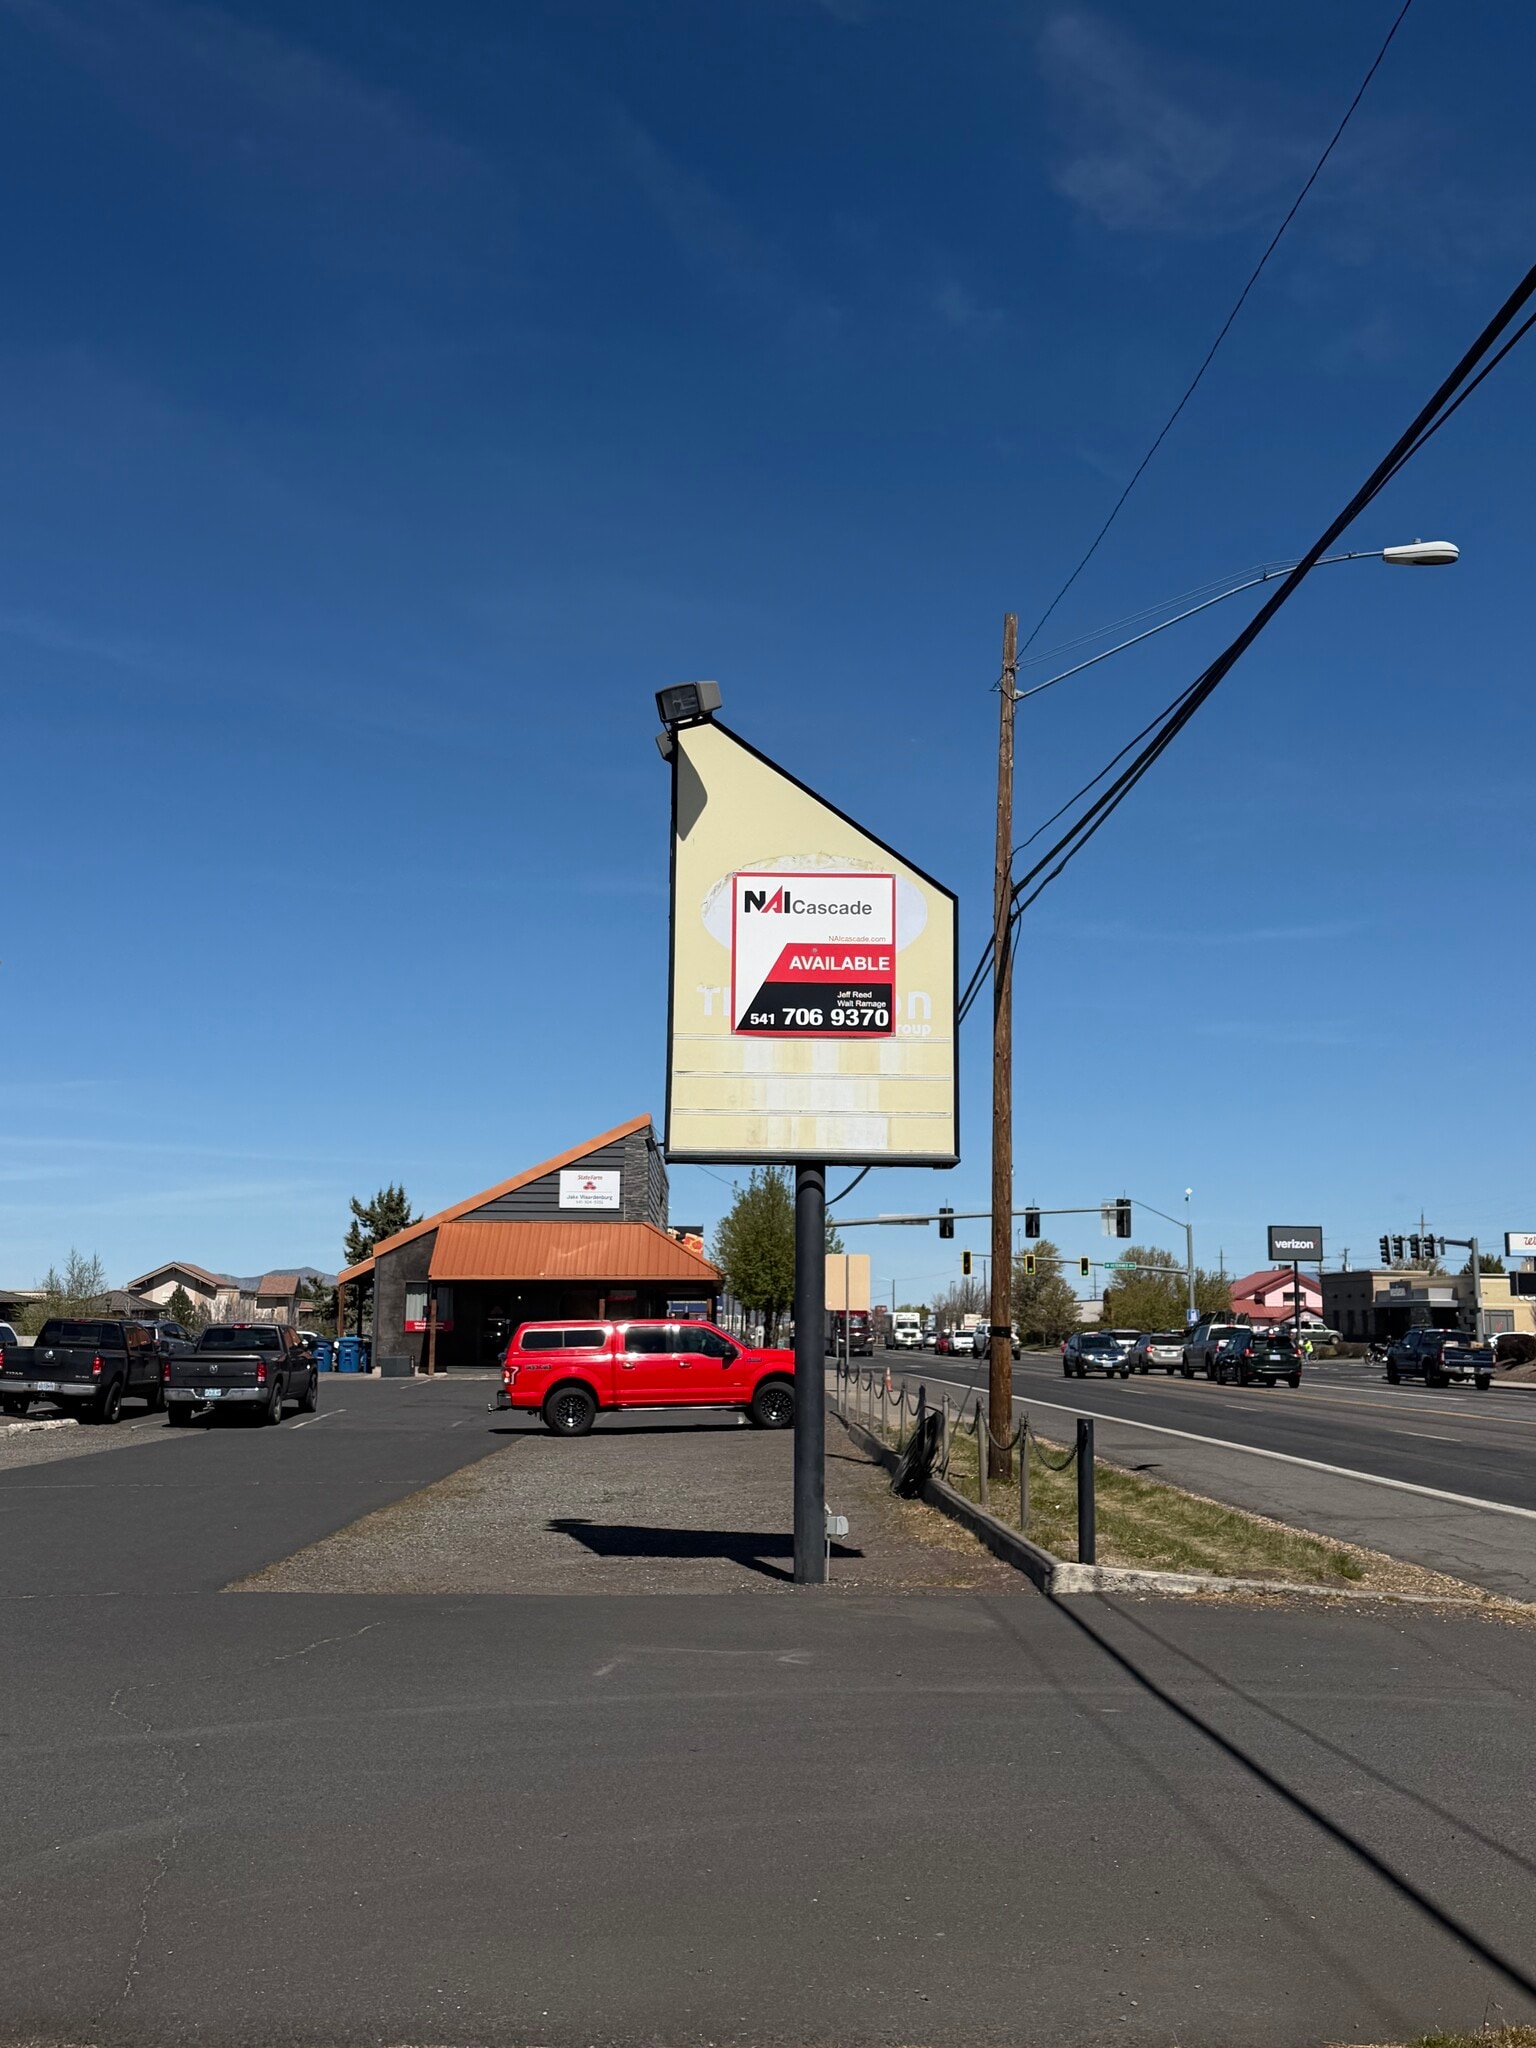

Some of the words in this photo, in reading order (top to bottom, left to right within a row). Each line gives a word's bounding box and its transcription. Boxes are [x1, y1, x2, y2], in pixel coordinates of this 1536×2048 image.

[744, 885, 791, 914] NAI
[792, 900, 873, 915] Cascade
[828, 935, 886, 943] NAIcascade.com
[789, 956, 890, 971] AVAILABLE
[837, 991, 851, 999] Jeff
[852, 991, 872, 999] Reed
[855, 1000, 886, 1009] Ramage
[750, 1013, 775, 1025] 541
[782, 1008, 823, 1026] 706
[830, 1008, 889, 1027] 9370
[897, 1023, 932, 1037] roup
[1274, 1238, 1315, 1250] verizon
